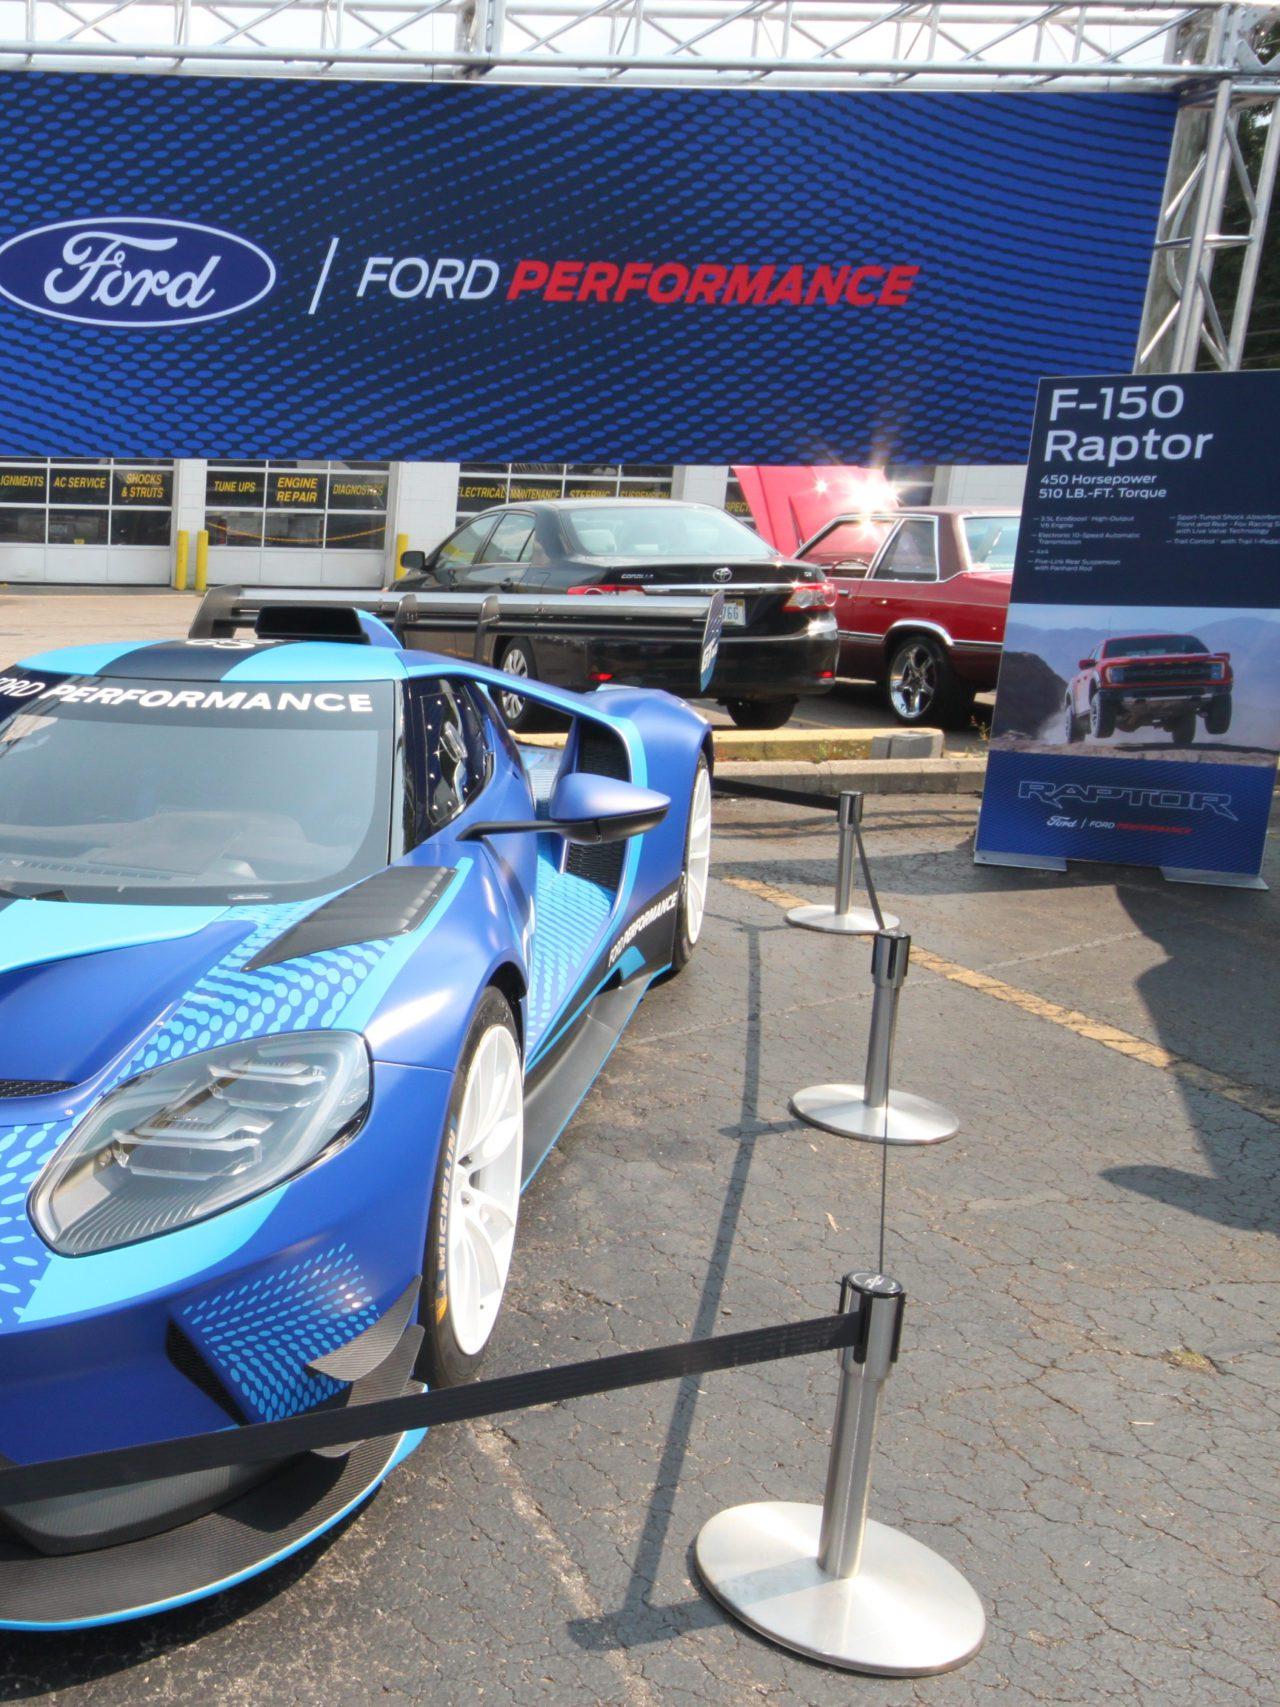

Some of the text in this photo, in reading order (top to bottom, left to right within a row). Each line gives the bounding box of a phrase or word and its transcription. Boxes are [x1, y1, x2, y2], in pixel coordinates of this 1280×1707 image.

[44, 232, 221, 309] Ford
[357, 256, 921, 306] FORD PERFORMANCE
[1049, 384, 1185, 422] F-150
[1043, 427, 1214, 468] Raptor
[53, 477, 107, 489] AC SERVICE
[125, 473, 163, 485] SHOCKS
[277, 477, 318, 489] ENGINE
[1040, 474, 1158, 486] 450 Horsepower
[121, 487, 164, 499] & STRUTS
[214, 480, 256, 493] TUNE UPS
[276, 491, 318, 503] REPAIR
[1038, 487, 1167, 500] 510 LB.-FT. Torque
[38, 684, 374, 712] PERFORMANCE
[1018, 780, 1239, 822] RAPTOR
[1046, 816, 1078, 828] Ford
[1089, 821, 1115, 829] FORD
[623, 890, 679, 945] PERFORMANCE
[438, 1128, 456, 1271] MICHELIN
